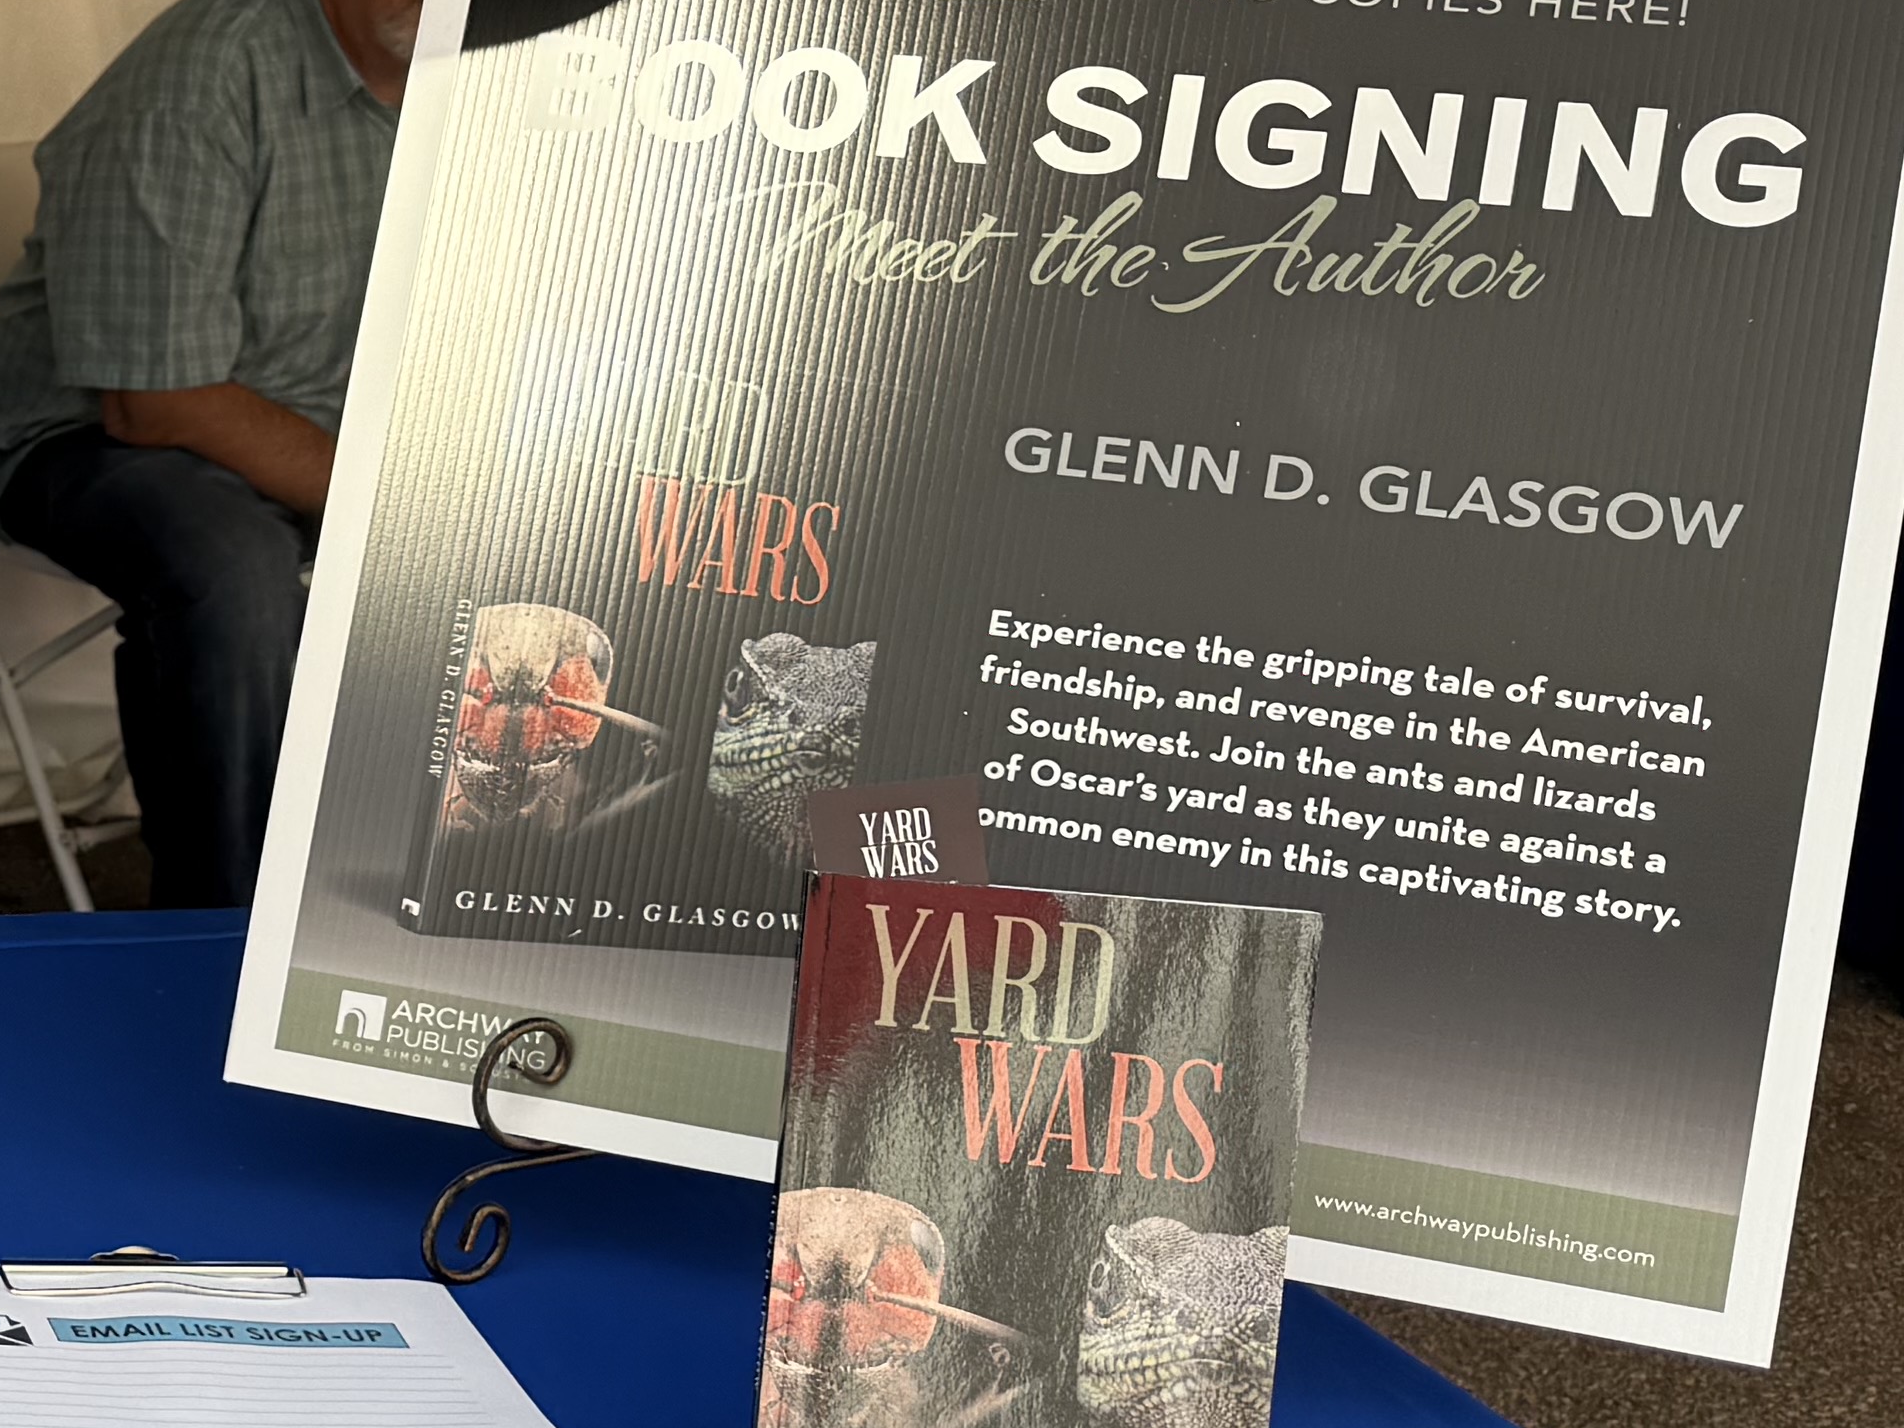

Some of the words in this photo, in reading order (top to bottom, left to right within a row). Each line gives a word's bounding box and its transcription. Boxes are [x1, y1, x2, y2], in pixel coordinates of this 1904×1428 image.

[525, 35, 995, 165] BOOK
[1033, 66, 1807, 228] SIGNING
[707, 180, 1018, 285] Meet
[1030, 191, 1156, 296] the
[1151, 194, 1546, 313] Author
[637, 475, 840, 606] WARS
[1004, 427, 1240, 495] GLENN
[1263, 454, 1330, 505] D.
[1359, 465, 1744, 549] GLASGOW
[444, 665, 461, 682] D.
[450, 599, 473, 659] GLENN
[988, 609, 1186, 659] Experience
[1195, 635, 1255, 668] the
[1262, 648, 1415, 696] gripping
[1424, 664, 1495, 699] tale
[1505, 675, 1549, 705] of
[1554, 689, 1712, 731] survival,
[428, 689, 456, 779] GLASGOW
[980, 654, 1165, 711] friendship,
[1175, 686, 1242, 716] and
[1249, 699, 1395, 741] revenge
[1405, 711, 1438, 742] in
[1449, 716, 1511, 751] the
[1520, 727, 1705, 777] American
[1006, 707, 1200, 759] Southwest.
[1209, 735, 1285, 771] Join
[1296, 746, 1356, 780] the
[1365, 762, 1444, 792] ants
[1453, 773, 1525, 803] and
[1533, 776, 1656, 821] lizards
[859, 807, 932, 846] YARD
[860, 840, 940, 879] WARS
[978, 808, 1102, 843] ommon
[1111, 827, 1232, 868] enemy
[1239, 837, 1272, 868] in
[1282, 843, 1349, 879] this
[1359, 863, 1566, 918] captivating
[1574, 888, 1681, 933] story.
[983, 753, 1024, 782] of
[1030, 759, 1158, 802] Oscar's
[1166, 785, 1247, 814] yard
[1254, 798, 1293, 821] as
[1303, 796, 1386, 841] they
[1394, 815, 1490, 849] unite
[1499, 833, 1635, 869] against
[1644, 853, 1667, 874] a
[455, 890, 576, 916] GLENN
[593, 901, 625, 920] D.
[643, 905, 802, 932] GLASGOW
[865, 904, 1115, 1046] YARD
[332, 1038, 376, 1055] FROM
[383, 1048, 432, 1066] SIMON
[442, 1058, 450, 1068] &
[954, 1038, 1224, 1184] WARS
[1314, 1193, 1656, 1269] www.archwaypublishing.com
[70, 1322, 172, 1340] EMAIL
[180, 1322, 235, 1340] LIST
[245, 1326, 382, 1343] SIGN-UP
